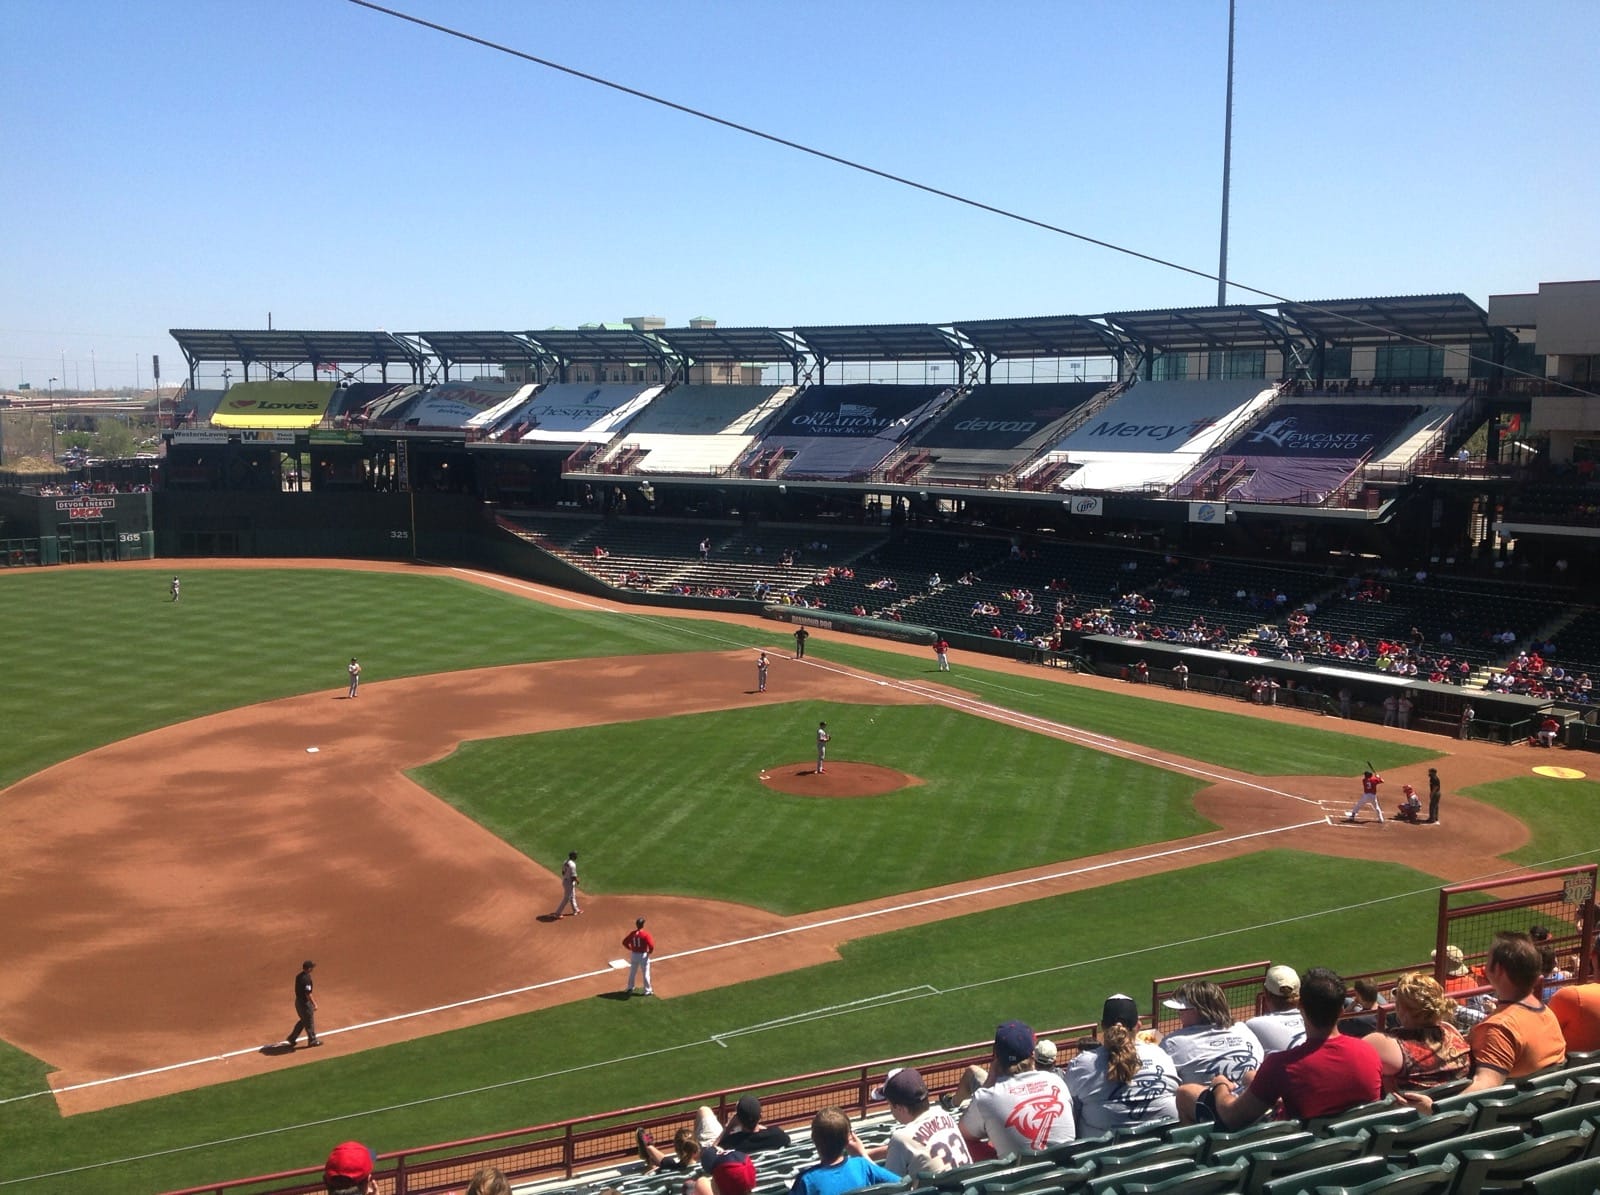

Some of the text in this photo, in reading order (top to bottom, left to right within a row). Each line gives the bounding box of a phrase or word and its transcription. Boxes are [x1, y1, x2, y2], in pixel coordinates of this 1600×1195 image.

[257, 400, 319, 410] Love's
[792, 415, 912, 427] OKLAHOMAN
[954, 417, 1037, 432] devon
[1088, 421, 1187, 441] Mercy
[242, 432, 275, 441] WM
[1288, 441, 1358, 449] CASINO
[70, 508, 103, 518] DECK
[119, 533, 141, 542] 365
[390, 531, 409, 539] 325
[1564, 884, 1593, 901] 202
